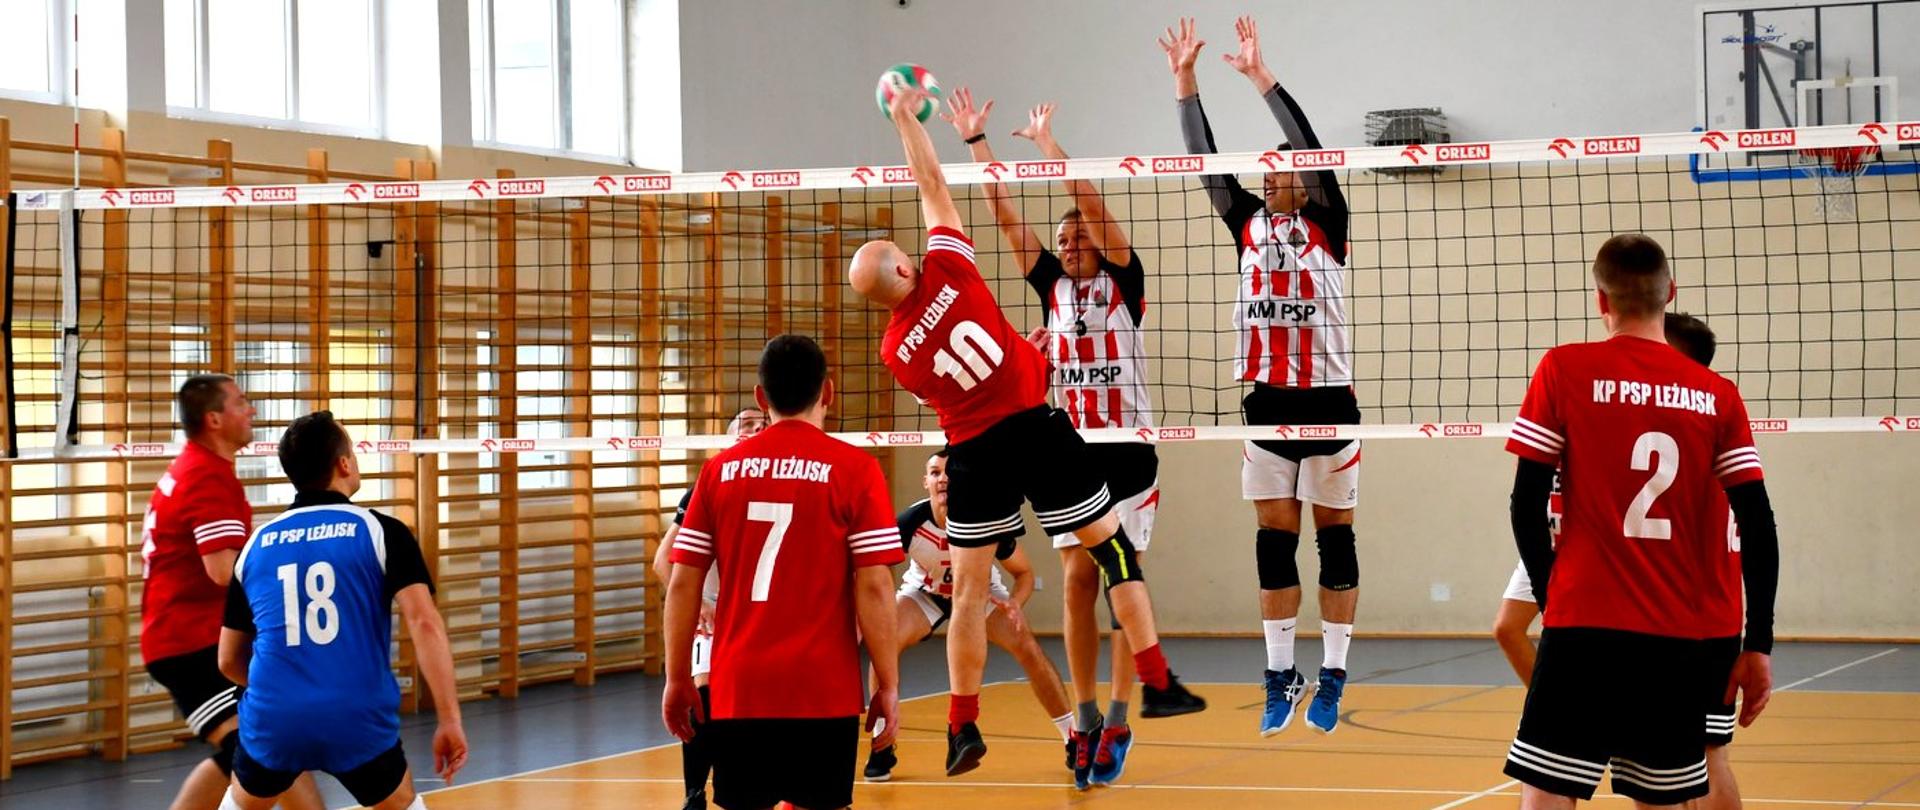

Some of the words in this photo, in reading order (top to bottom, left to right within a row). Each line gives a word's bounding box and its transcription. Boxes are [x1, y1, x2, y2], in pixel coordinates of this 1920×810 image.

[1740, 132, 1793, 147] ORLEN
[1438, 146, 1488, 160] ORLEN
[1586, 139, 1638, 154] ORLEN
[1155, 158, 1202, 172] ORLEN
[1295, 152, 1343, 166] ORLEN
[885, 169, 913, 181] ORL
[1018, 163, 1063, 176] ORLEN
[628, 178, 669, 190] ORLEN
[755, 174, 798, 186] ORLEN
[253, 188, 295, 200] ORLEN
[376, 185, 418, 197] ORLEN
[501, 182, 542, 194] ORLEN
[132, 191, 173, 203] ORLEN
[1247, 301, 1276, 318] KM
[1281, 303, 1317, 322] PSP
[896, 344, 912, 364] KP
[904, 324, 927, 351] PSP
[919, 283, 960, 331] LEŻAJSK
[932, 320, 1004, 392] 10
[1061, 368, 1084, 384] KM
[1089, 366, 1121, 383] PSP
[1593, 379, 1616, 403] KP
[1619, 380, 1652, 406] PSP
[1655, 382, 1717, 416] LEŻAJSK
[1445, 425, 1480, 435] ORLEN
[1750, 421, 1785, 430] ORLEN
[890, 434, 921, 443] ORLEN
[1161, 429, 1194, 439] ORLEN
[1301, 428, 1335, 437] ORLEN
[503, 441, 533, 450] ORLEN
[630, 439, 661, 448] ORLEN
[720, 460, 740, 483] KP
[740, 457, 770, 478] PSP
[771, 456, 832, 483] LEŻAJSK
[1623, 431, 1679, 540] 2
[260, 531, 278, 548] KP
[279, 528, 305, 544] PSP
[306, 522, 357, 541] LEŻAJSK
[747, 501, 793, 602] 7
[277, 561, 340, 647] 18
